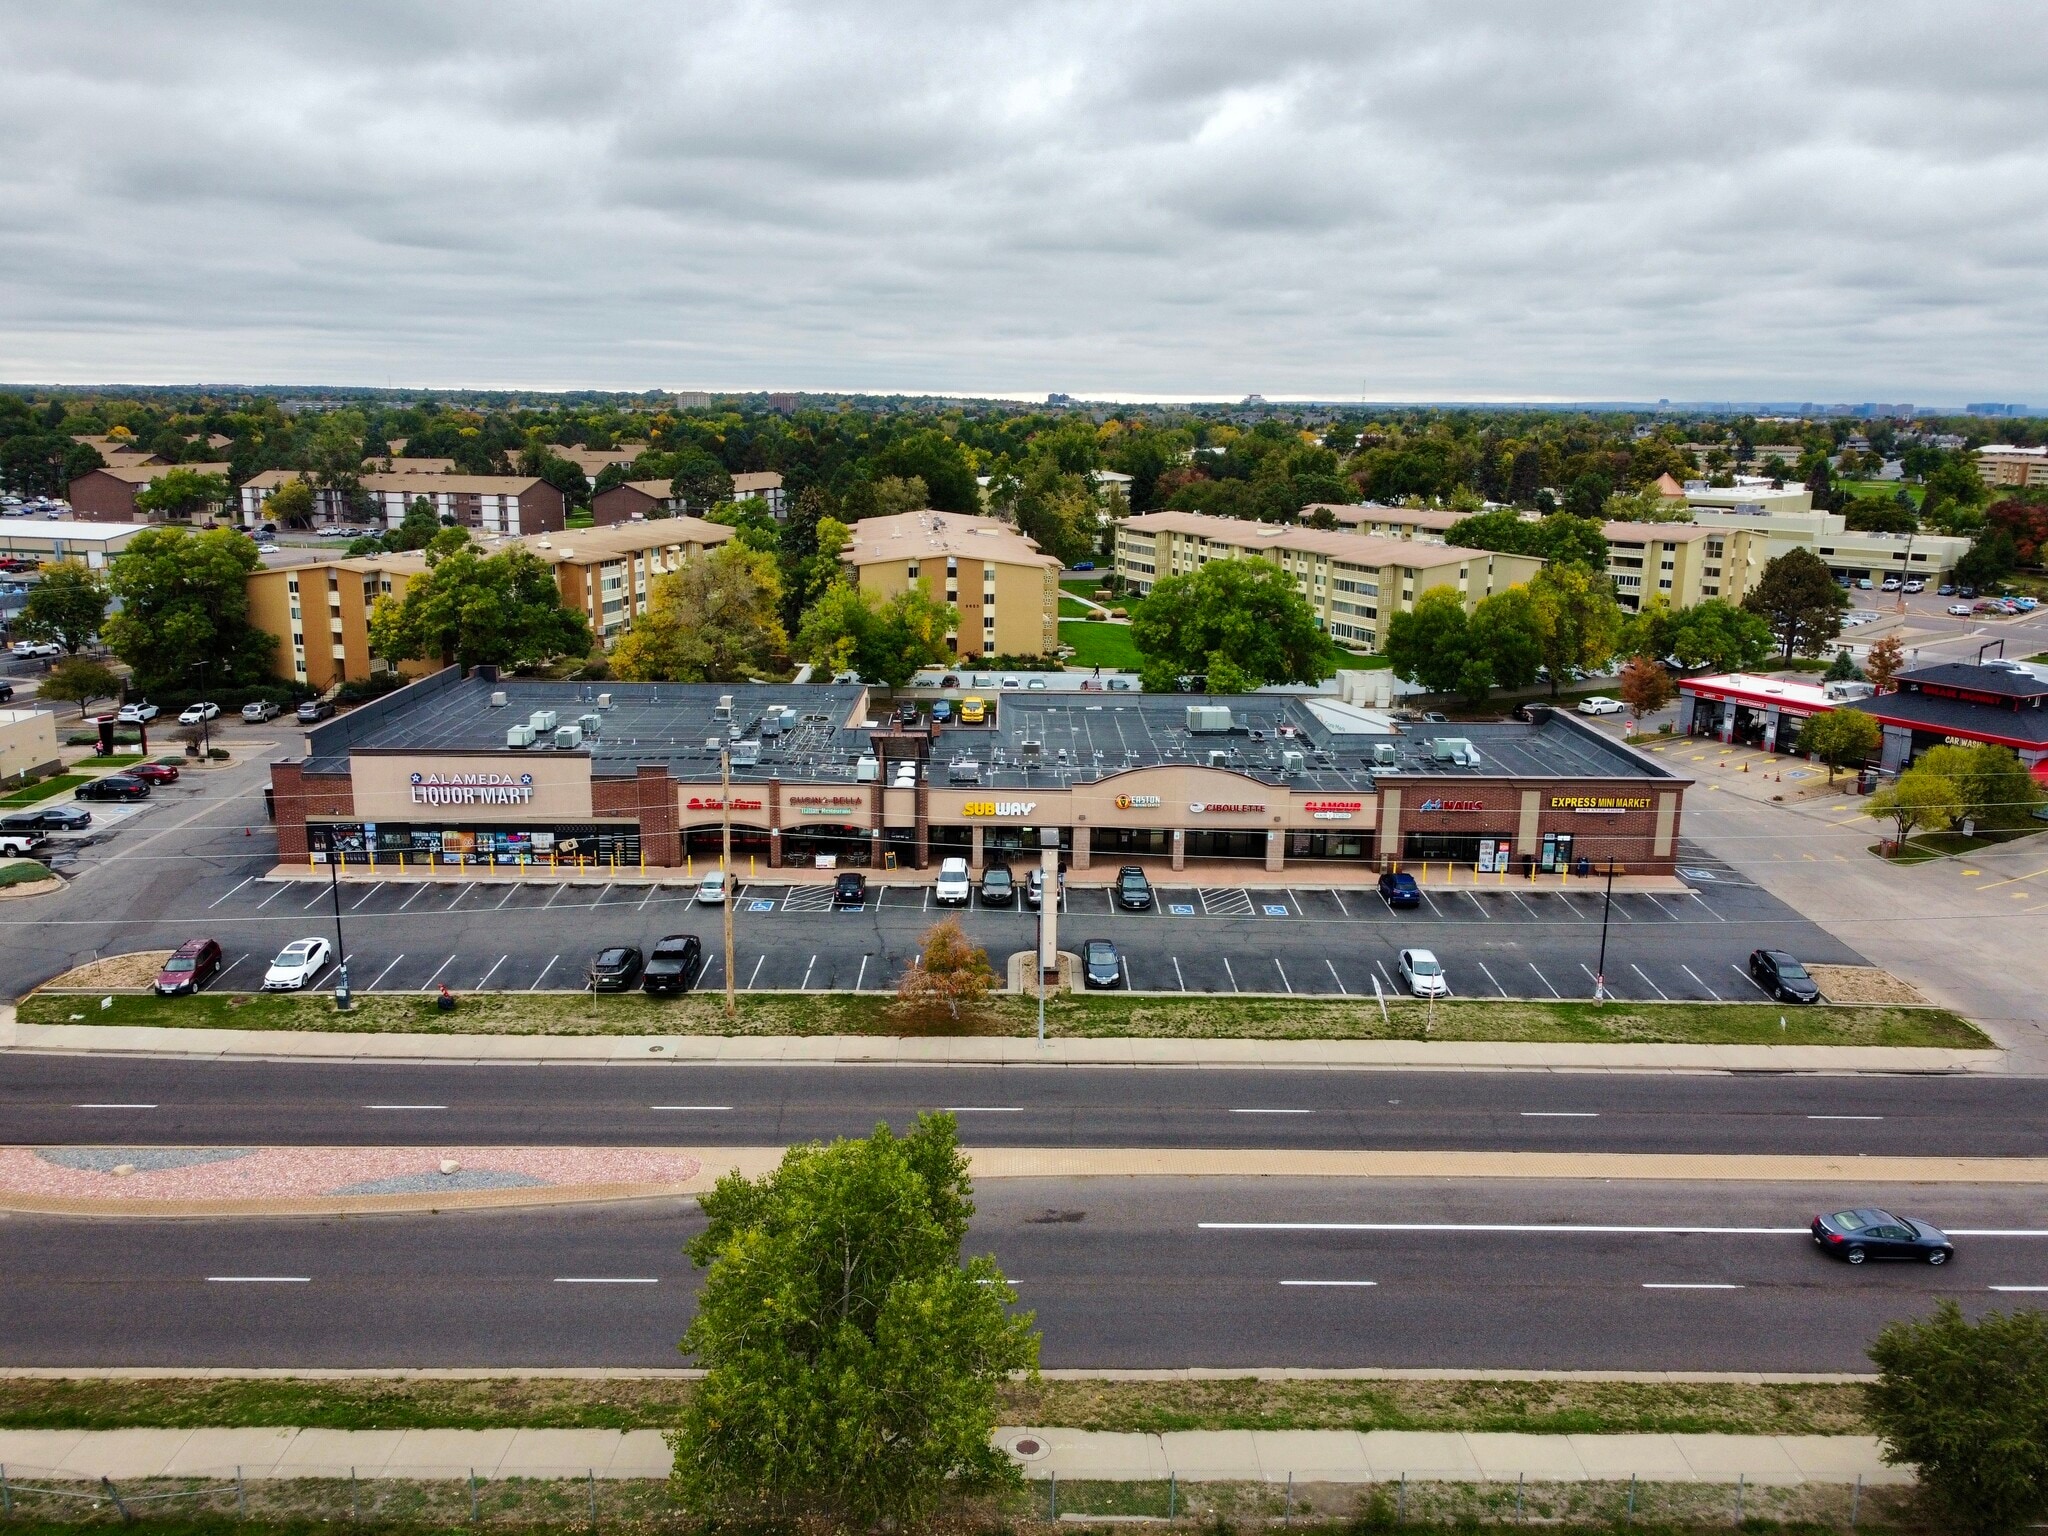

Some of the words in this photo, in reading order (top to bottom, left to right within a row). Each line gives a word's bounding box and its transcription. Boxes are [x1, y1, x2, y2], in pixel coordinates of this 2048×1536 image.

[1945, 736, 1959, 744] CAR
[428, 773, 515, 785] ALAMEDA
[411, 786, 475, 807] LIQUOR
[480, 787, 532, 804] MART
[832, 796, 862, 805] BELLA
[1131, 796, 1160, 804] EASTON
[705, 799, 733, 809] Stae
[1305, 802, 1361, 811] GLAMOUR
[1443, 801, 1482, 811] NAILS
[1551, 797, 1597, 807] EXPRESS
[1597, 798, 1615, 808] MINI
[1615, 798, 1651, 808] MARKET
[962, 802, 1036, 816] SUBWAY
[1206, 804, 1266, 812] CIBOULETTE
